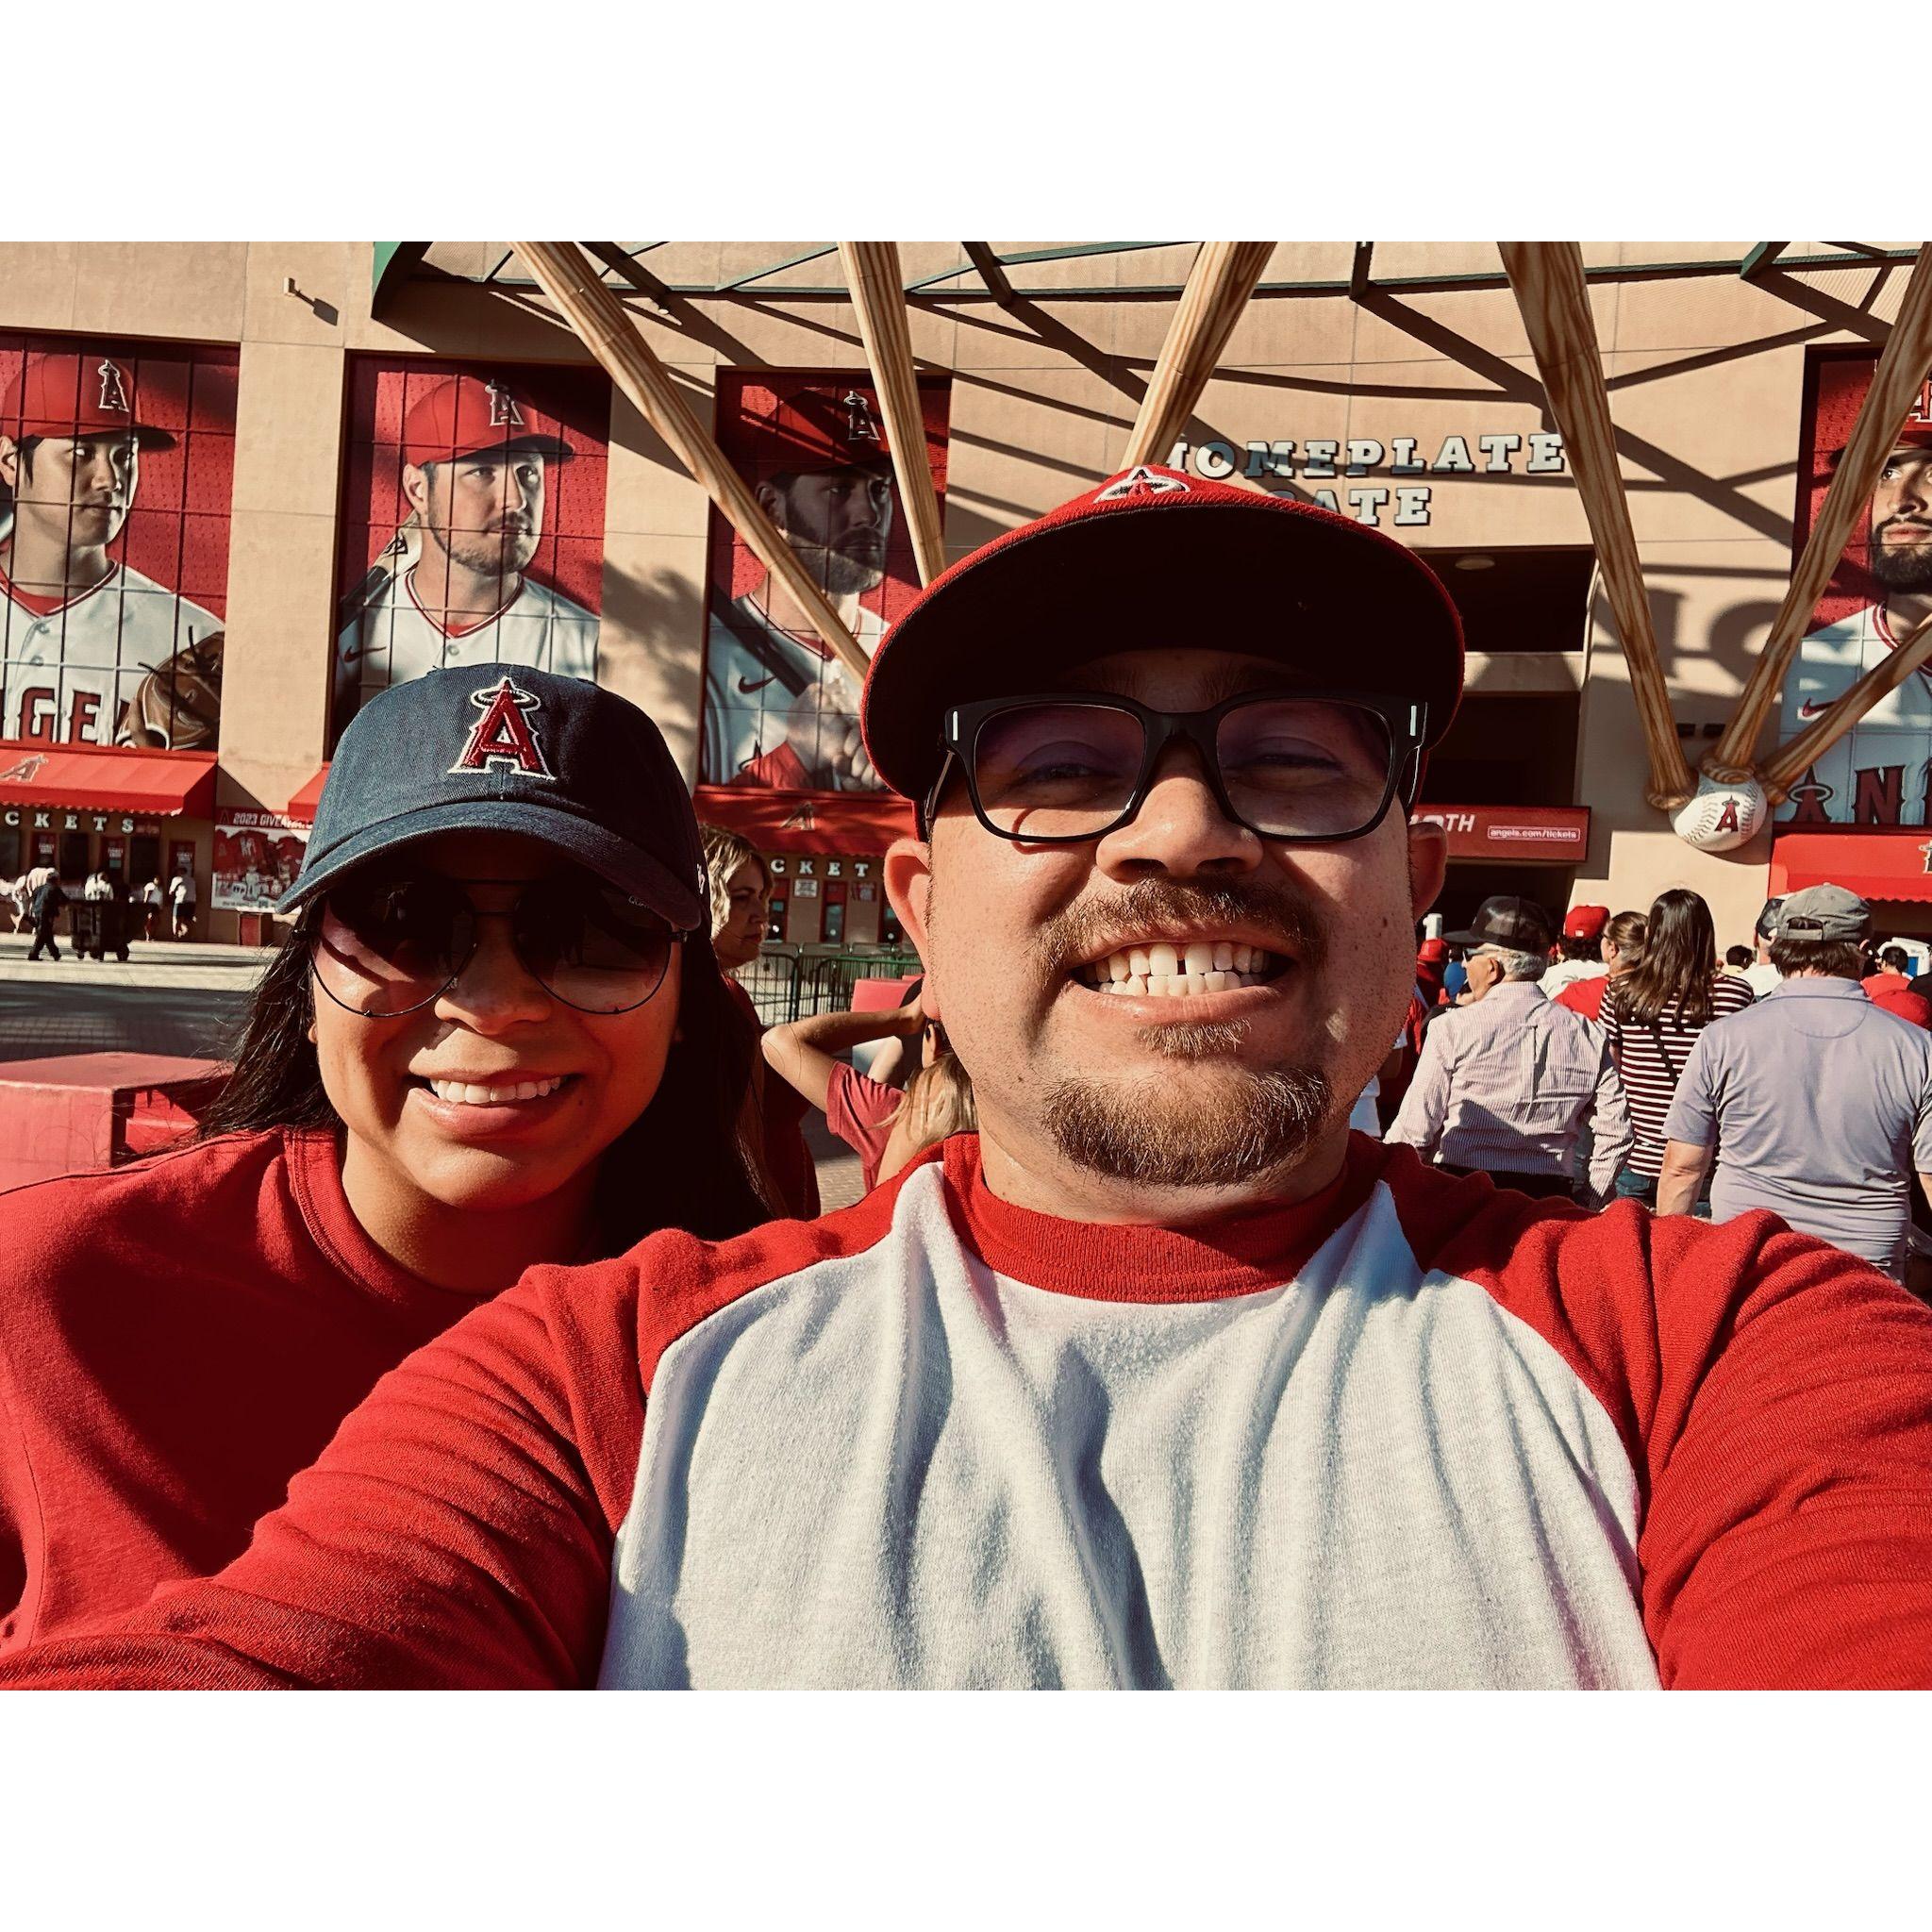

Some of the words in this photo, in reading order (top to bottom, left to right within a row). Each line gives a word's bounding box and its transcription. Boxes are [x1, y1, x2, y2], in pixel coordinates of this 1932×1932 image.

[1269, 487, 1432, 526] ATE
[447, 675, 558, 781] A
[1789, 764, 1932, 824] AN
[5, 810, 134, 834] CKETS
[233, 812, 258, 825] 2023
[1714, 794, 1739, 832] A
[1490, 828, 1577, 840] angels.com/tickets
[770, 858, 869, 877] CKET
